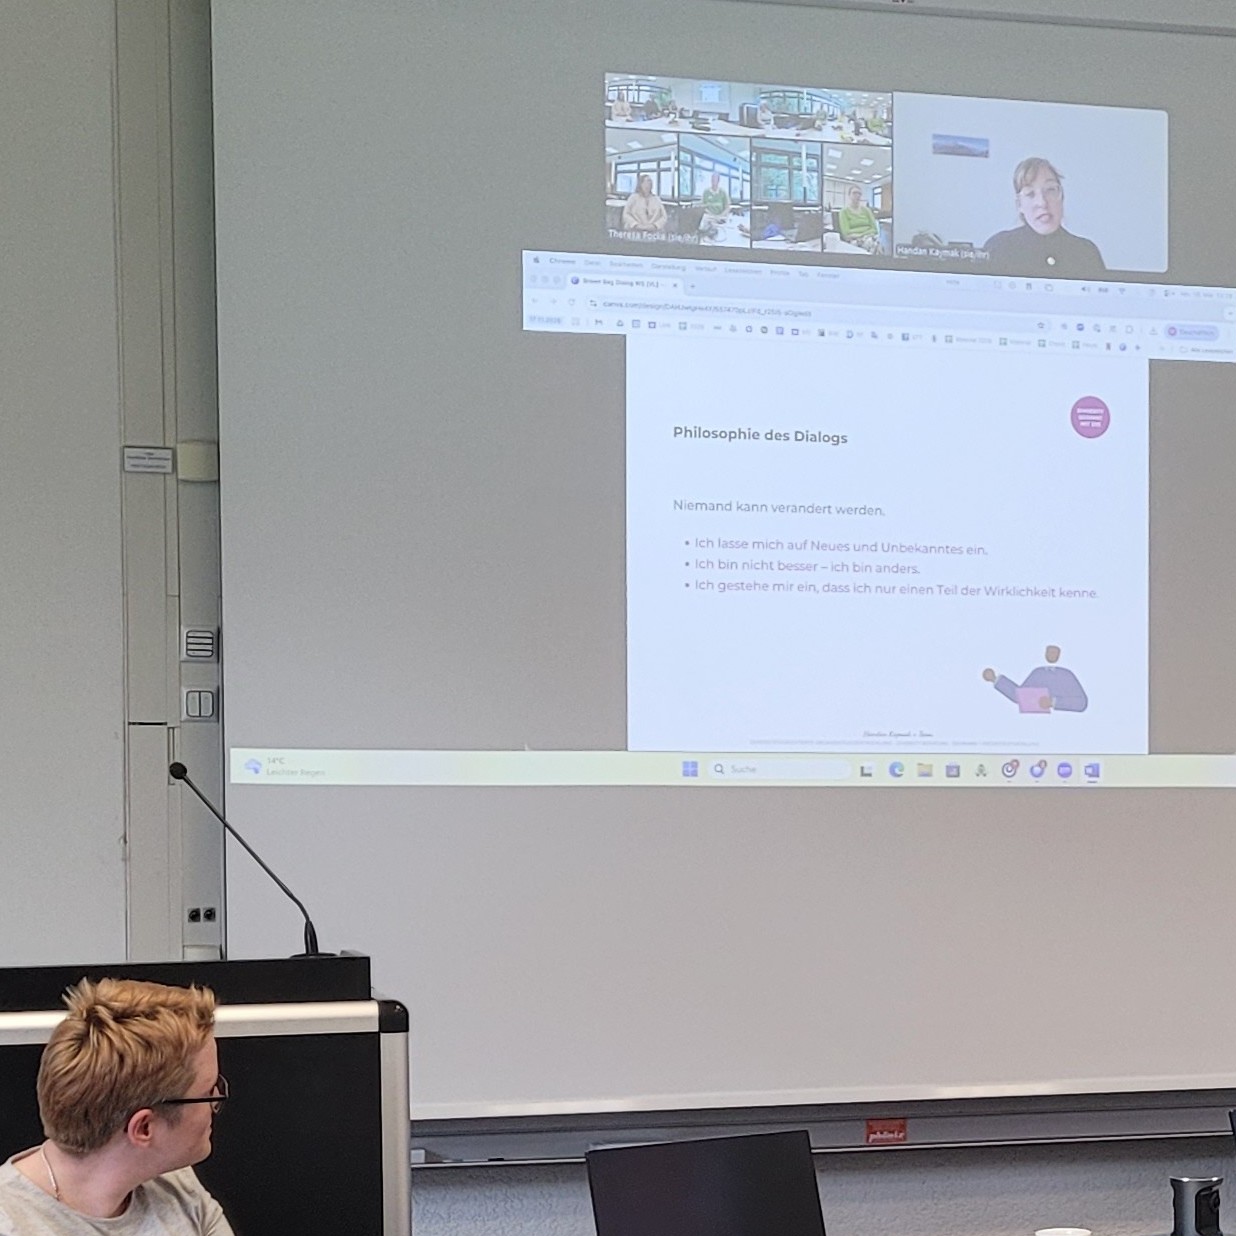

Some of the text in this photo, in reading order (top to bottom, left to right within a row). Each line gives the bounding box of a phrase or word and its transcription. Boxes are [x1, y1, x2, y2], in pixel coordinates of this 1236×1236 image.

[673, 425, 848, 446] Philosophie des Dialogs
[673, 499, 732, 513] Niemand
[736, 501, 768, 513] kann
[835, 504, 886, 517] werden.
[695, 537, 988, 556] Ich lasse mich auf Neues und Unbekanntes ein.
[695, 558, 714, 570] Ich
[717, 558, 738, 570] bin
[741, 559, 774, 571] nicht
[777, 560, 819, 572] besser
[830, 561, 849, 573] ich
[852, 561, 872, 573] bin
[875, 562, 921, 575] anders.
[695, 579, 714, 591] Ich
[717, 580, 769, 594] gestehe
[772, 580, 795, 592] mir
[797, 581, 820, 595] ein,
[822, 582, 850, 594] dass
[853, 582, 871, 594] ich
[874, 585, 896, 595] nur
[899, 584, 934, 596] einen
[936, 584, 957, 596] Teil
[960, 584, 982, 597] der
[983, 585, 1057, 599] Wirklichkeit
[267, 757, 285, 765] 14°C
[730, 764, 757, 773] Suche
[266, 768, 326, 778] Leichter Regen
